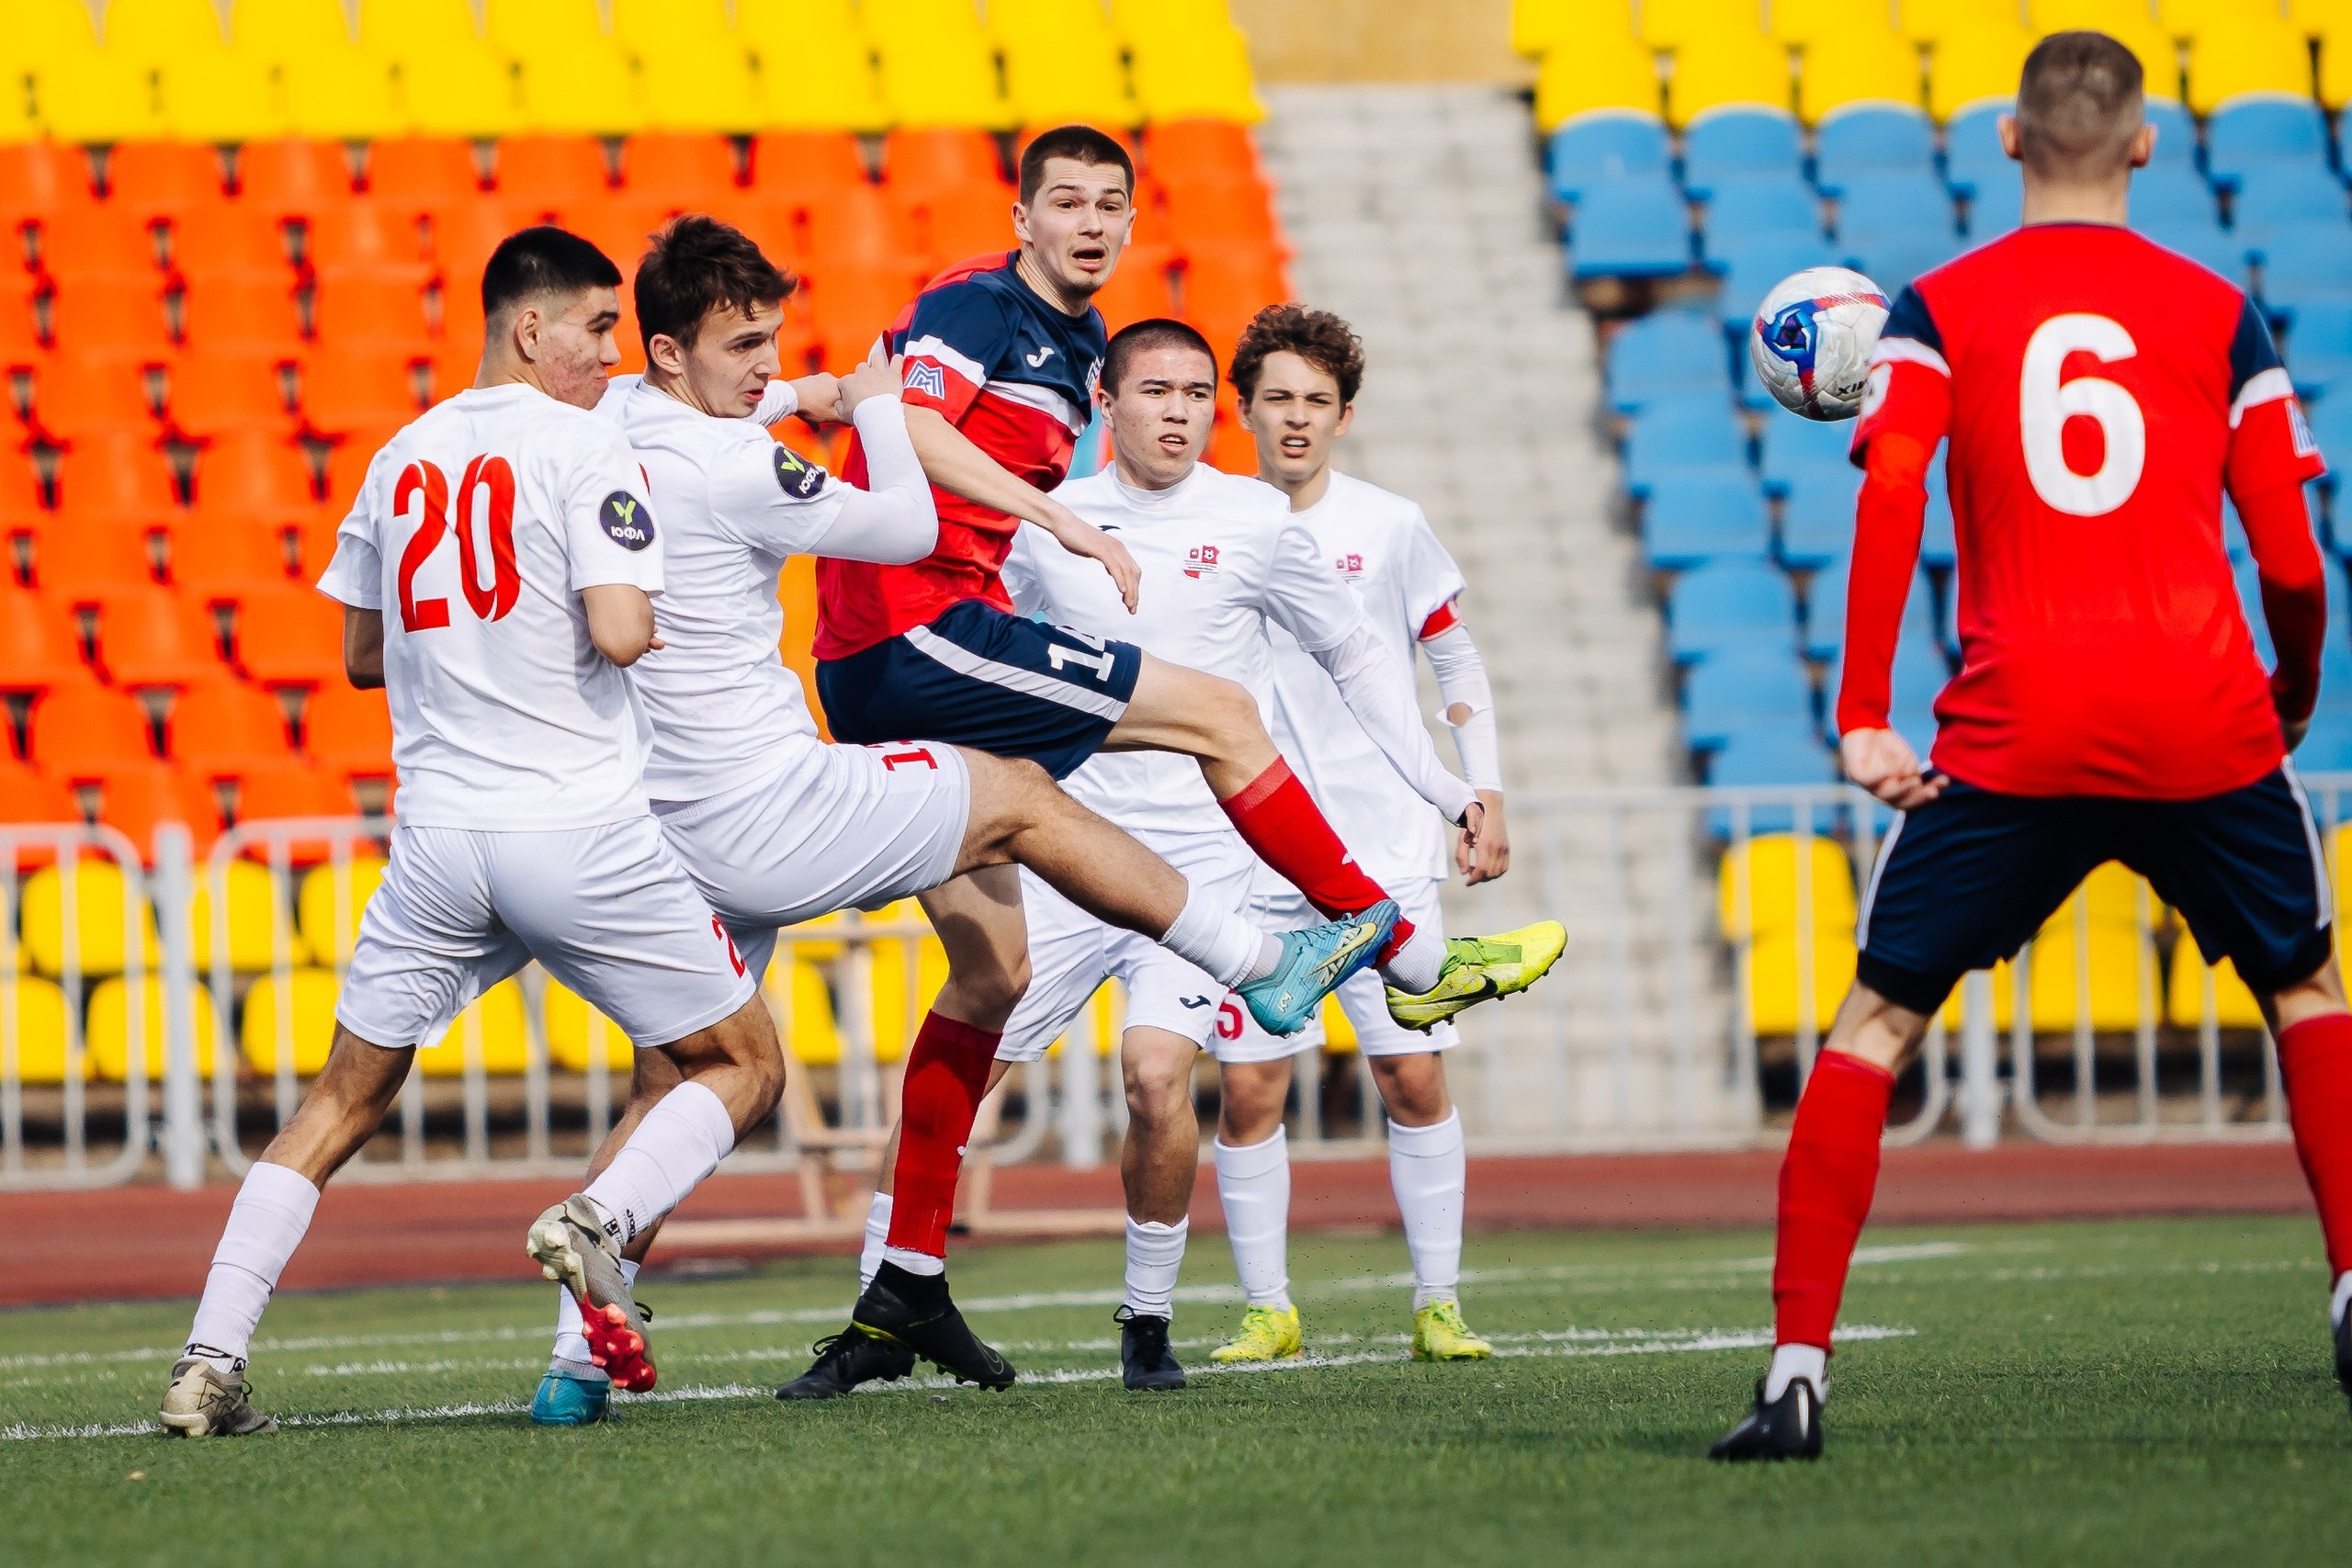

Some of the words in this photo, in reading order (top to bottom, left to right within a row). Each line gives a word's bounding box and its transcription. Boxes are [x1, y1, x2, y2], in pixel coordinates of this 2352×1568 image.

[2021, 313, 2146, 516] 6
[392, 451, 522, 634] 20
[610, 525, 646, 541] ЮФЛ
